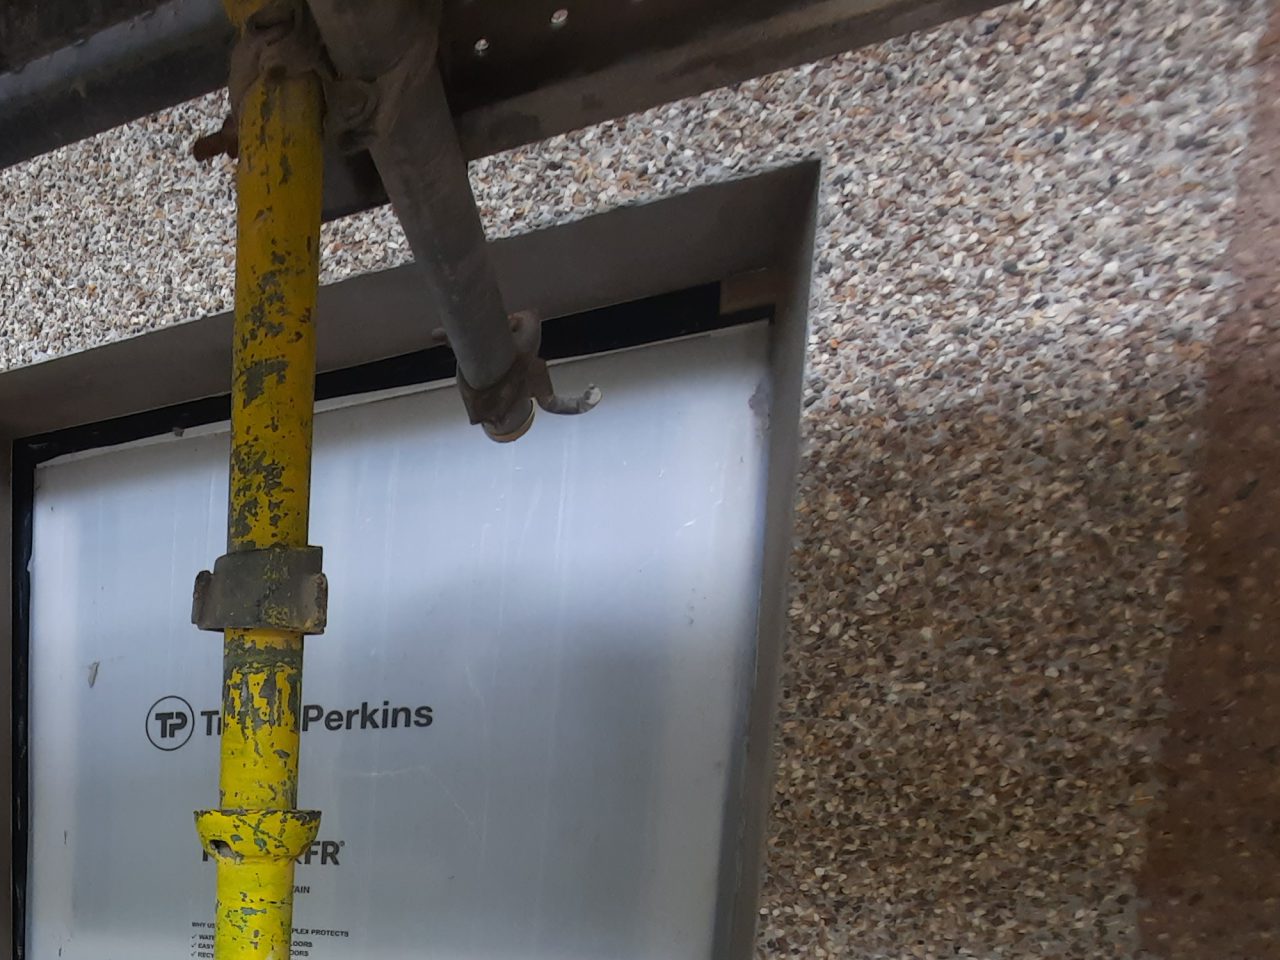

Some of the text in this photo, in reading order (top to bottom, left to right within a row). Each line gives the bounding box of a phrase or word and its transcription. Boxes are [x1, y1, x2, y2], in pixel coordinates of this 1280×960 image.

[155, 712, 187, 738] TP
[302, 701, 434, 731] Perkins
[311, 929, 349, 937] PROTECTS
